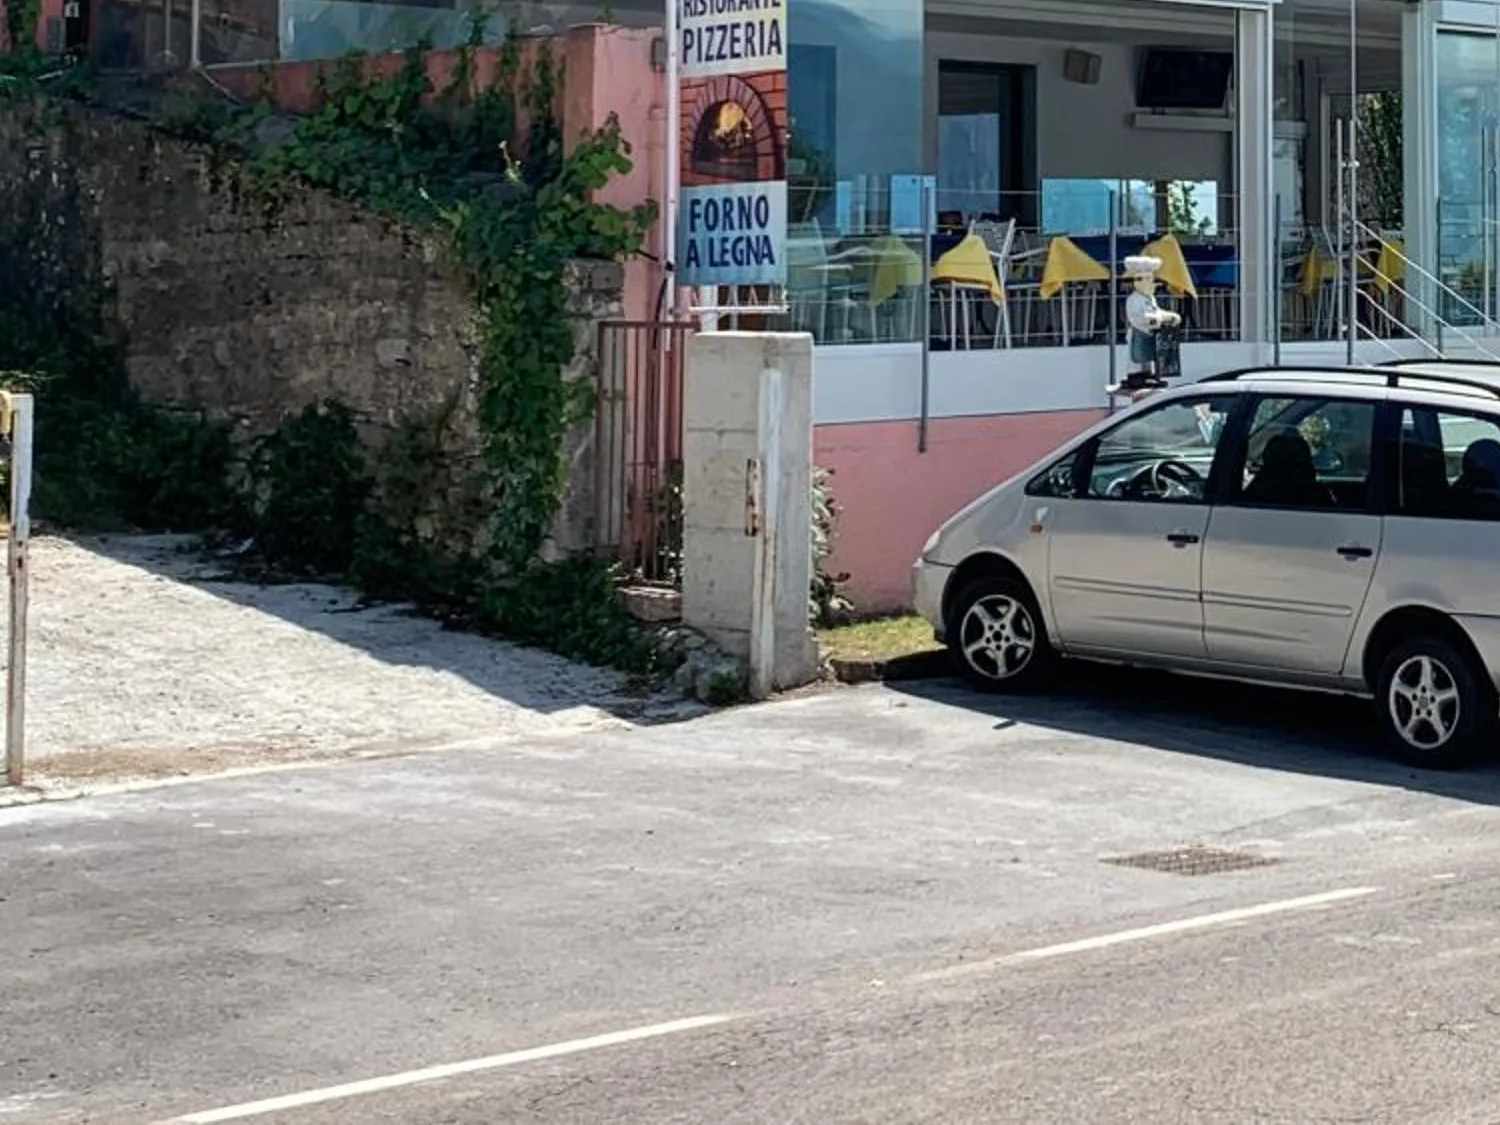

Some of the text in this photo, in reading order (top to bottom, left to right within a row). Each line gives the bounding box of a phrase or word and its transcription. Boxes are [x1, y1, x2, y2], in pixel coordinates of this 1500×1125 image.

[682, 18, 783, 65] PIZZERIA
[690, 194, 769, 233] FORNO
[685, 234, 776, 268] A LEGNA
